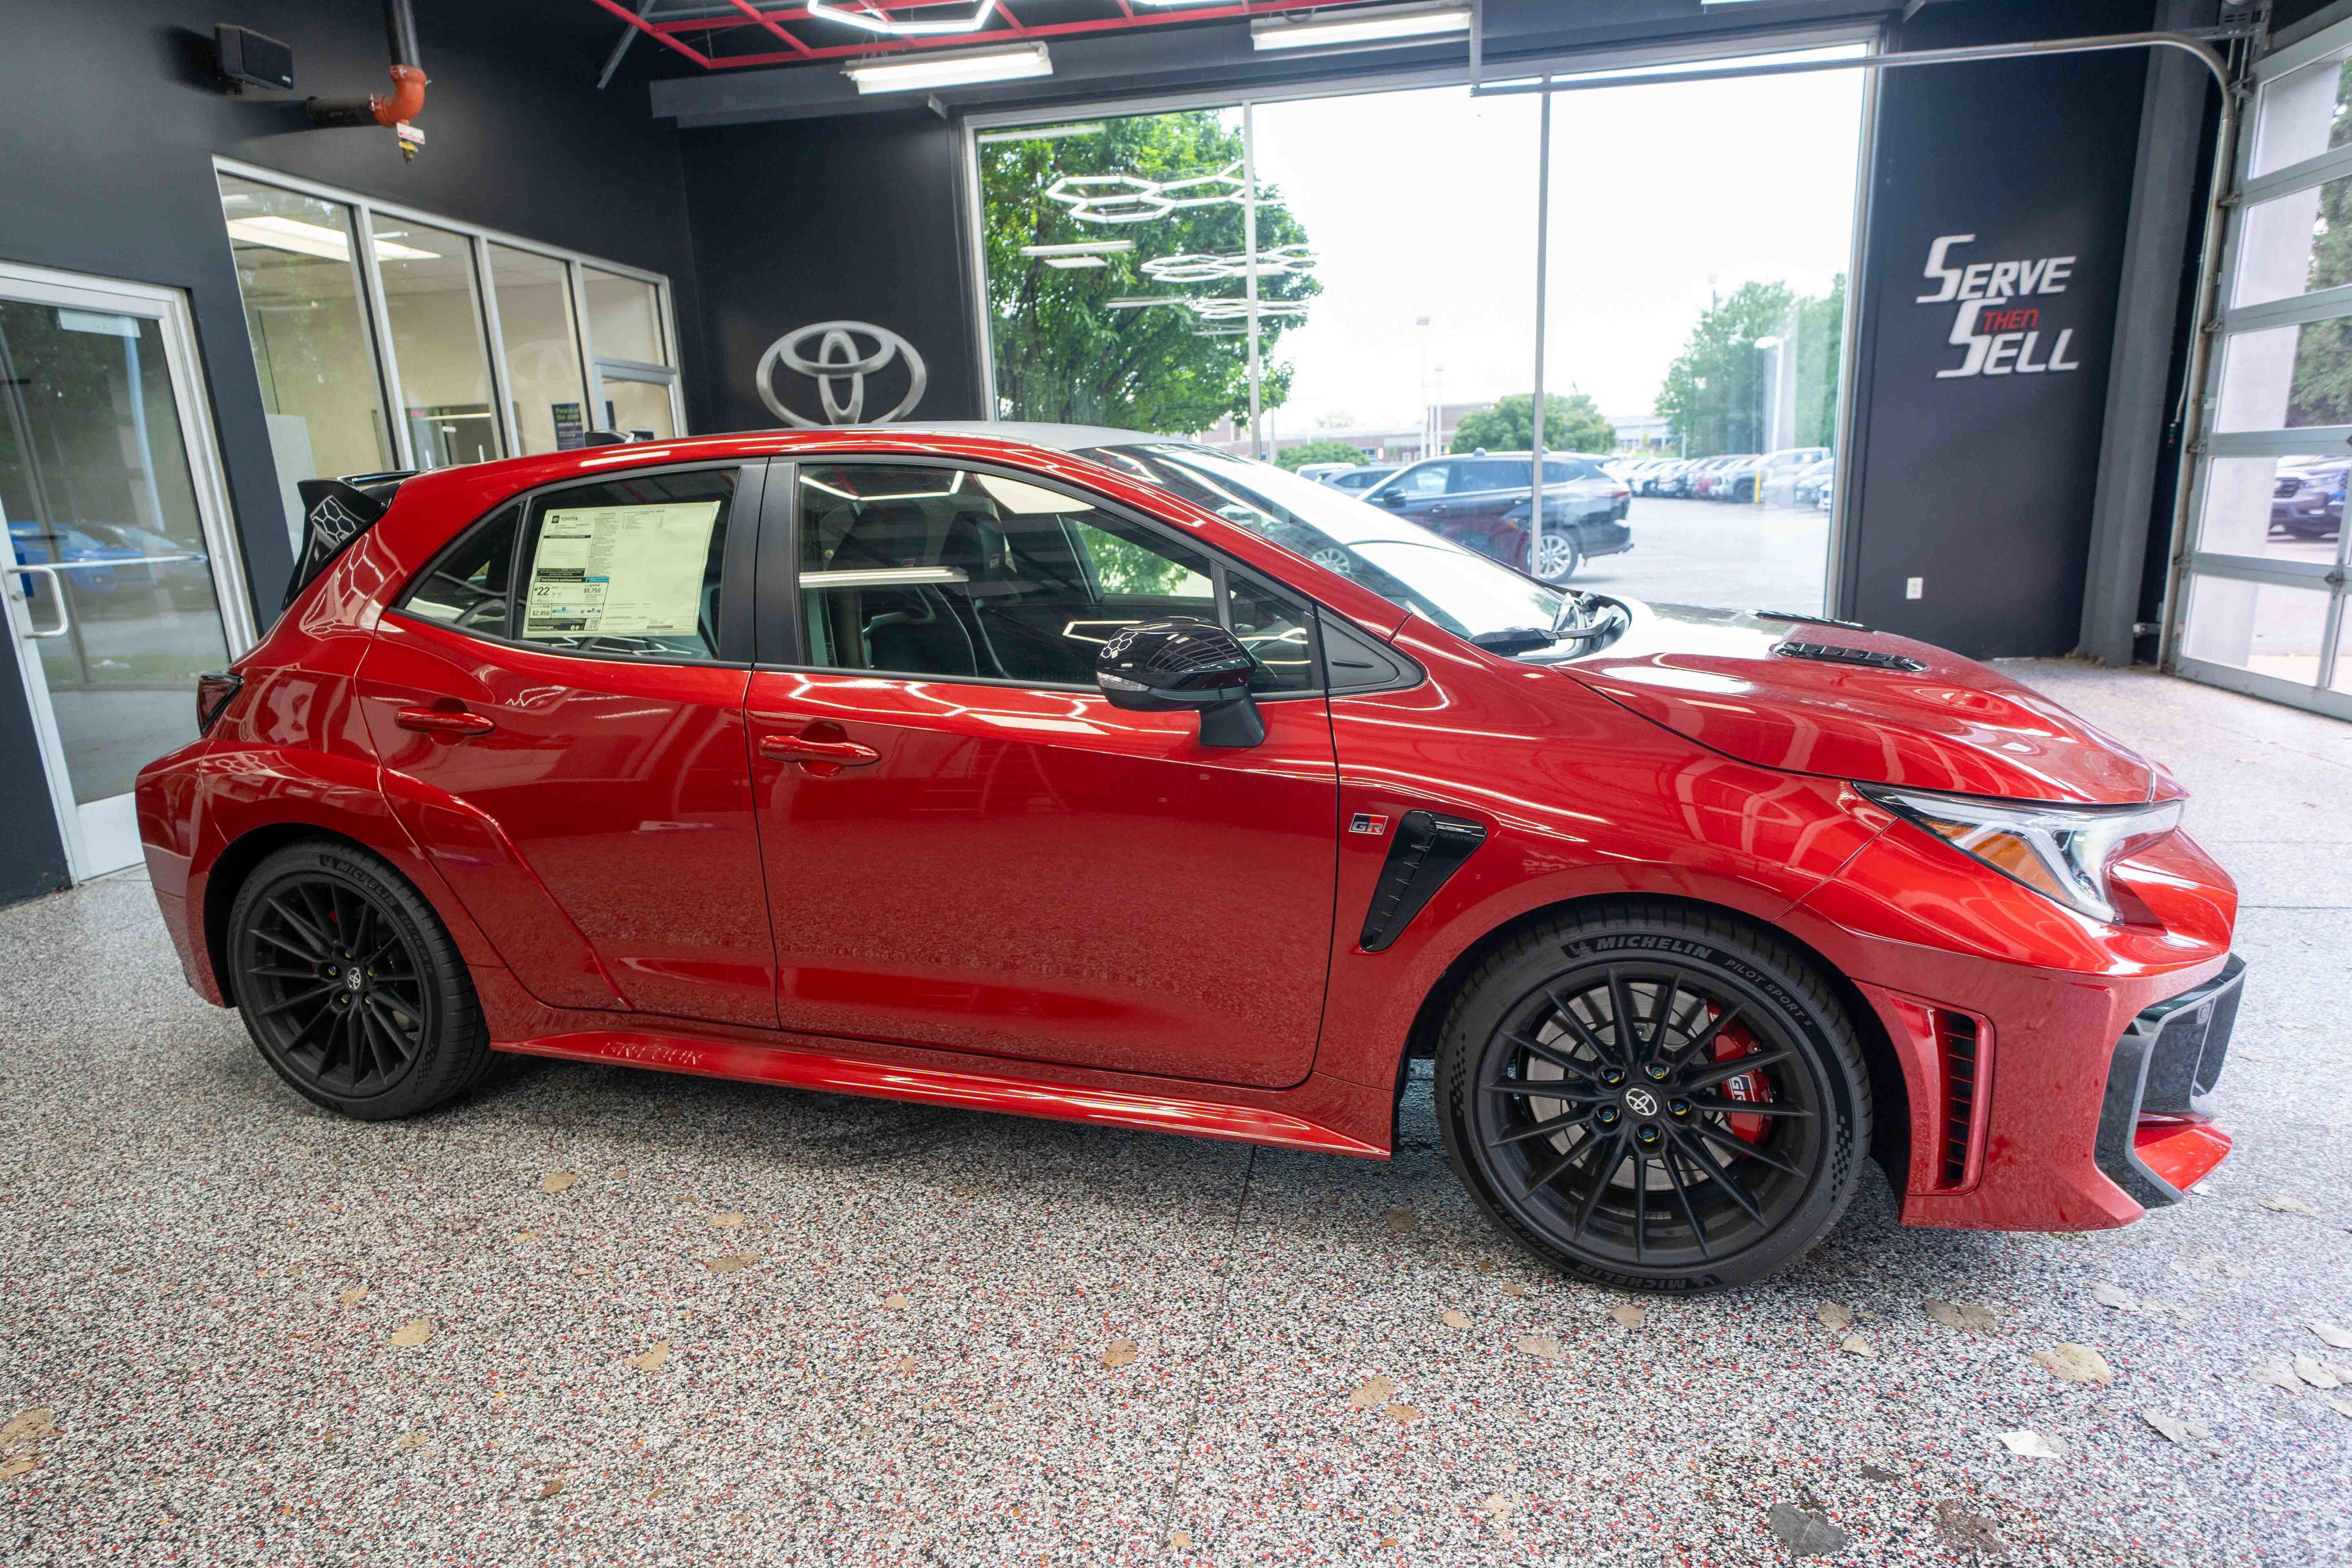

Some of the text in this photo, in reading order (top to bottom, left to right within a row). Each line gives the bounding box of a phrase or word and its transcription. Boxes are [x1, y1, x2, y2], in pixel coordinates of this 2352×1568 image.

[1915, 234, 2076, 303] SERVE
[1983, 308, 2039, 330] THEN
[1936, 297, 2079, 378] SELL
[990, 559, 999, 568] GR
[537, 587, 550, 596] 22
[1352, 821, 1383, 833] GR
[337, 861, 398, 906] MICHELIN
[1597, 936, 1712, 959] MICHELIN
[1725, 960, 1765, 982] PILOT
[1764, 983, 1805, 1017] SPORT
[1577, 1265, 1687, 1290] MICHELIN
